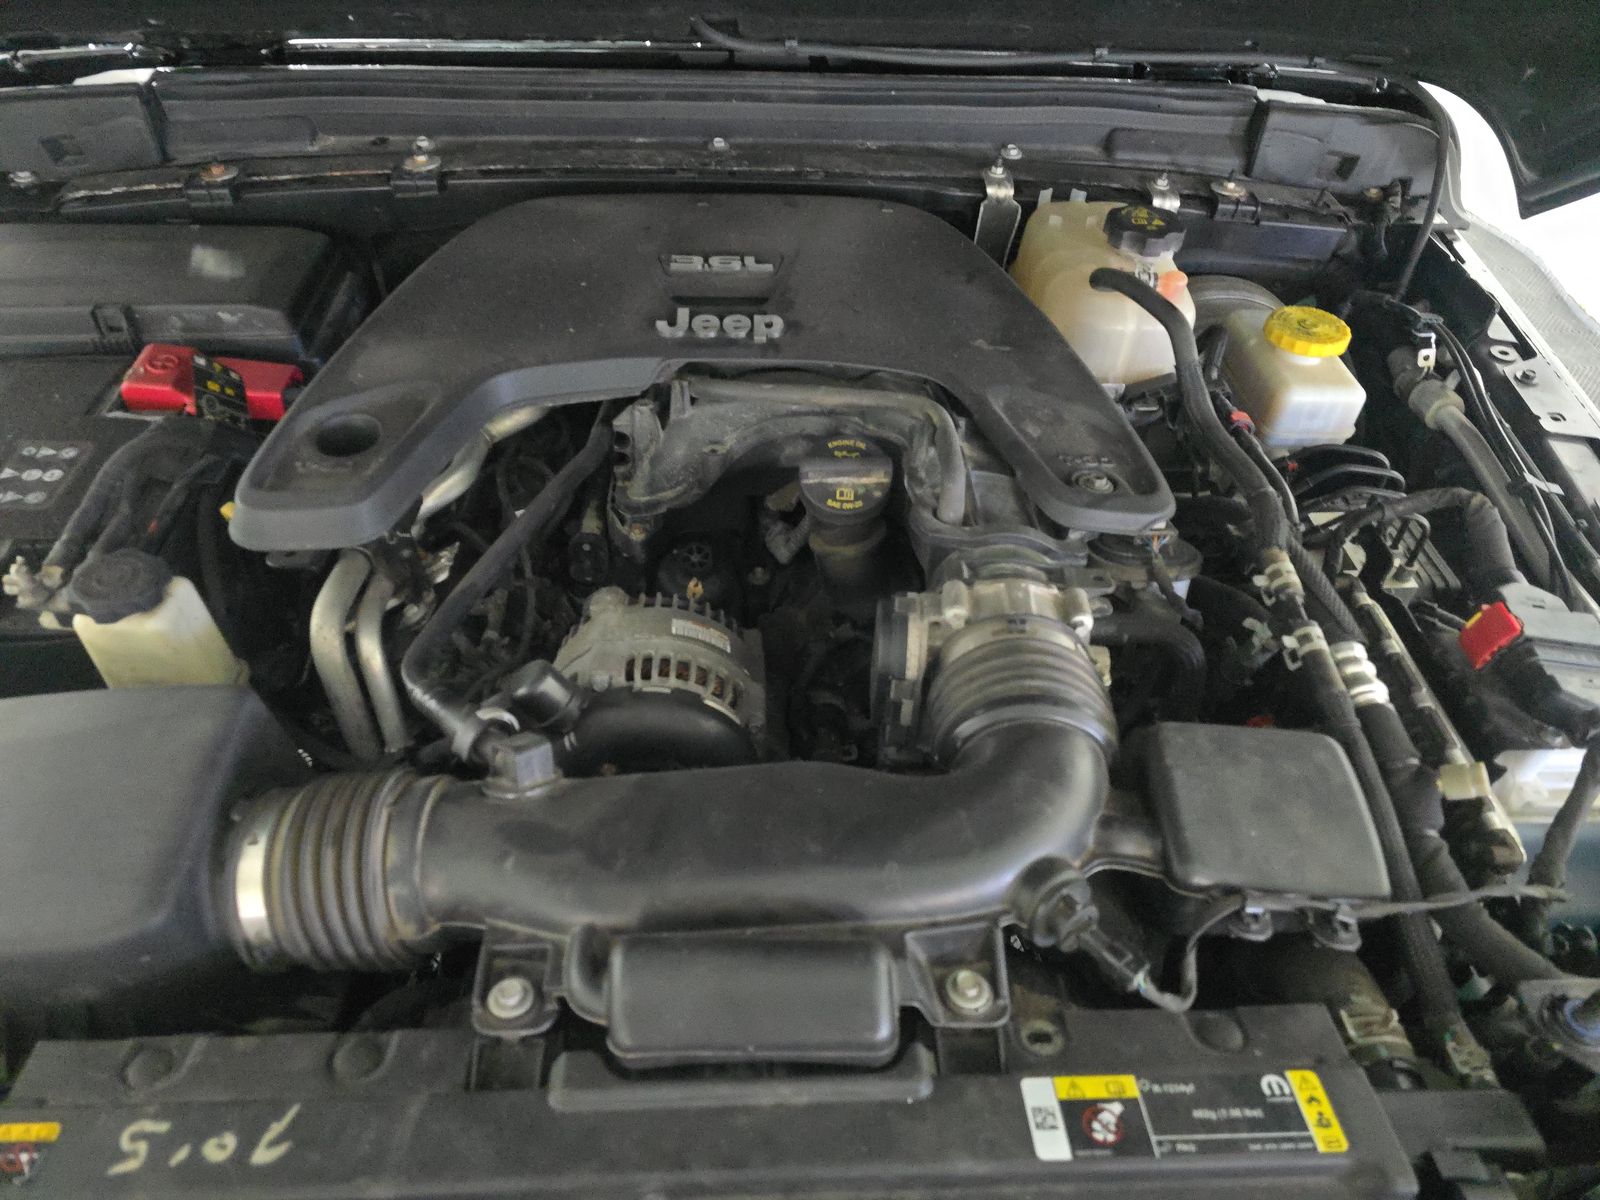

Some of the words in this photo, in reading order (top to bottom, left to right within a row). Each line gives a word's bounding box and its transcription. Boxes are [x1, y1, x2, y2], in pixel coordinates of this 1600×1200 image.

[670, 254, 774, 272] 3.6L
[655, 307, 785, 344] Jeep
[827, 439, 855, 449] ENGINE
